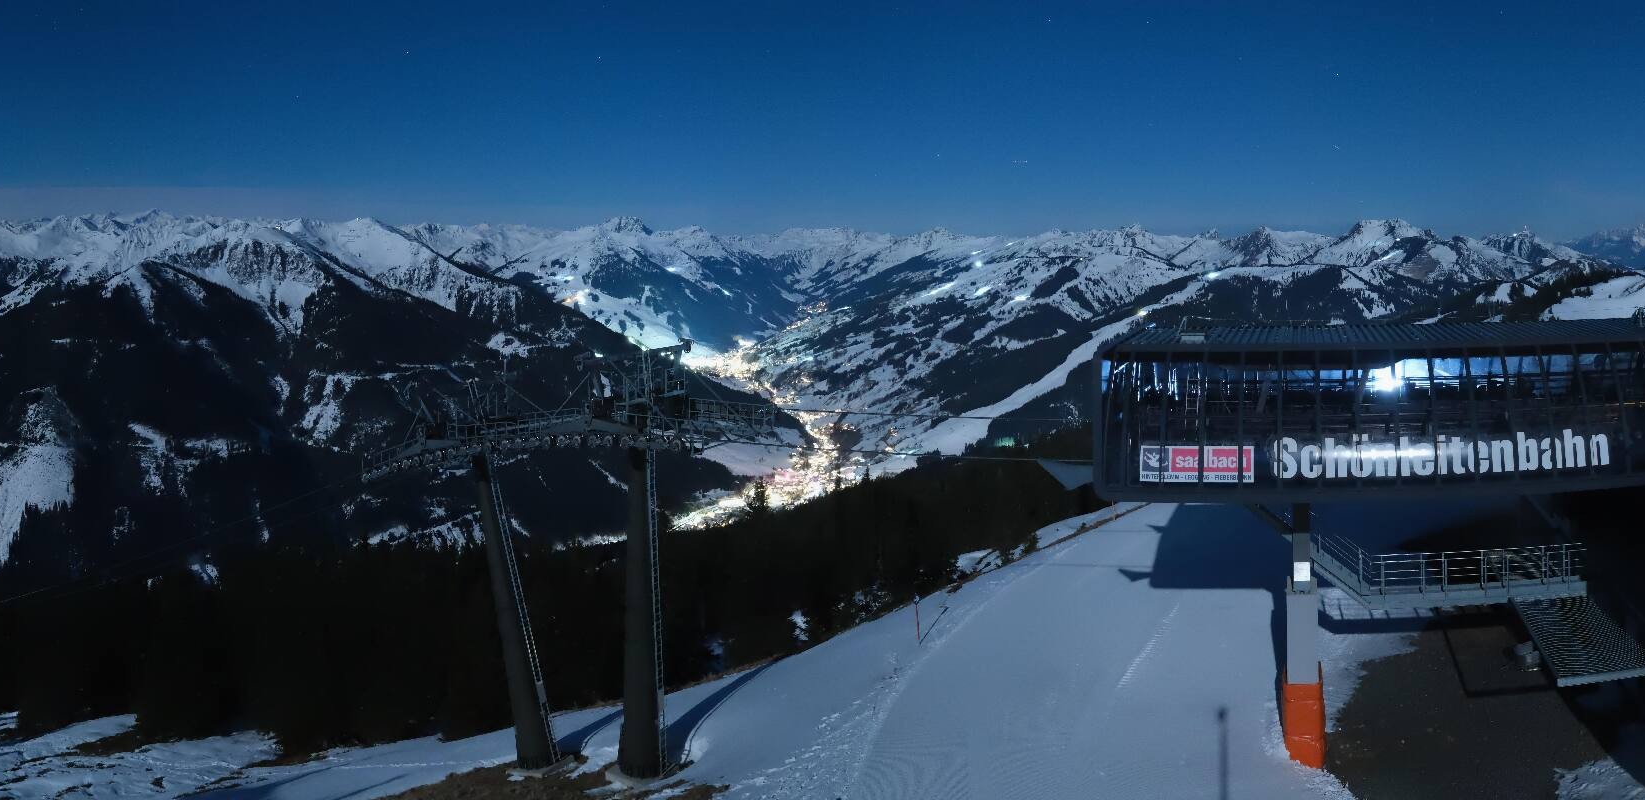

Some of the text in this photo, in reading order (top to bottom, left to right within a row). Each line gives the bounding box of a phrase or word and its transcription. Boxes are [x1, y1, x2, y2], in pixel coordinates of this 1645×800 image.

[1273, 429, 1610, 478] Schönleitenbahn
[1184, 473, 1210, 481] LEOGNG
[1214, 473, 1252, 481] FIEBERBNN
